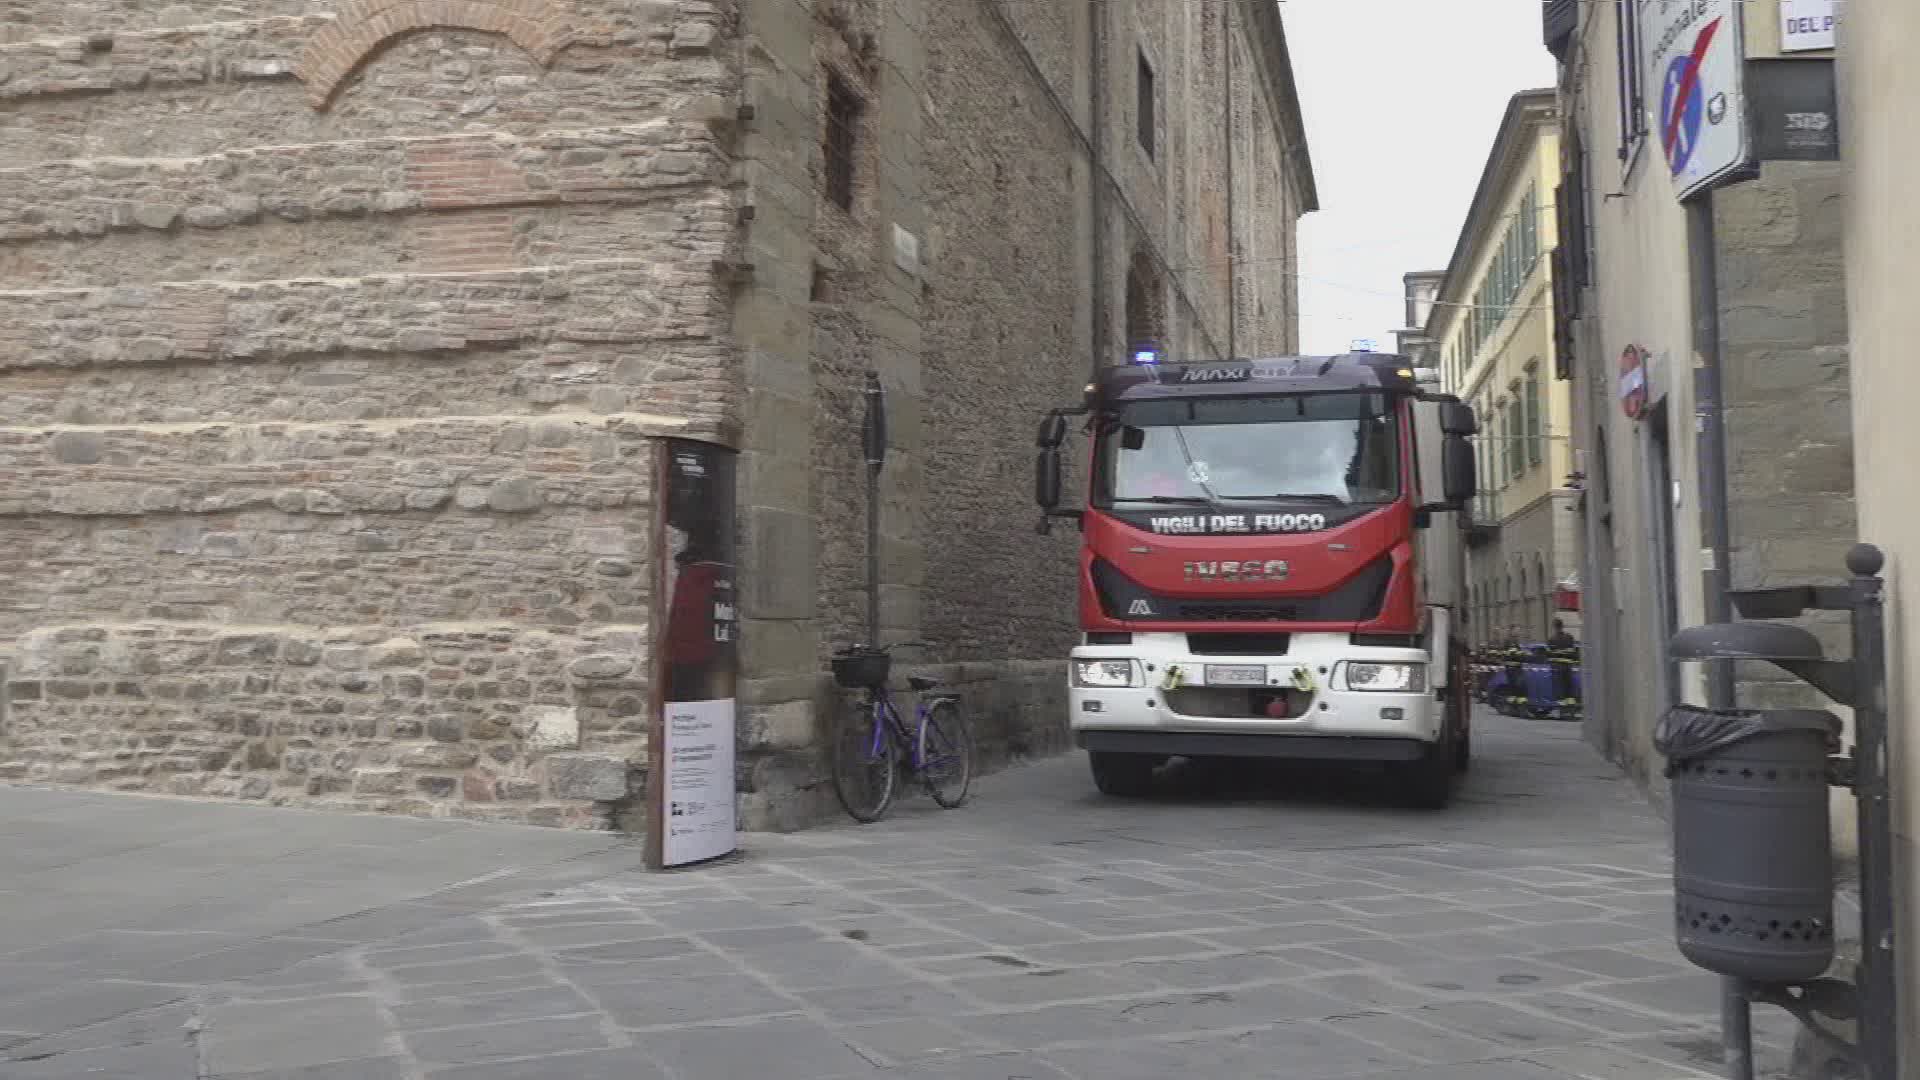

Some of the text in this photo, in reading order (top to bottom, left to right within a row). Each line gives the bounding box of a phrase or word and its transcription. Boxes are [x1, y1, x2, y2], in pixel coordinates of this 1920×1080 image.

[1787, 17, 1819, 34] DEL
[1181, 365, 1297, 381] MAXI CITY
[1151, 513, 1326, 533] VIGILI DEL FUOCO
[1183, 560, 1289, 582] IVECO
